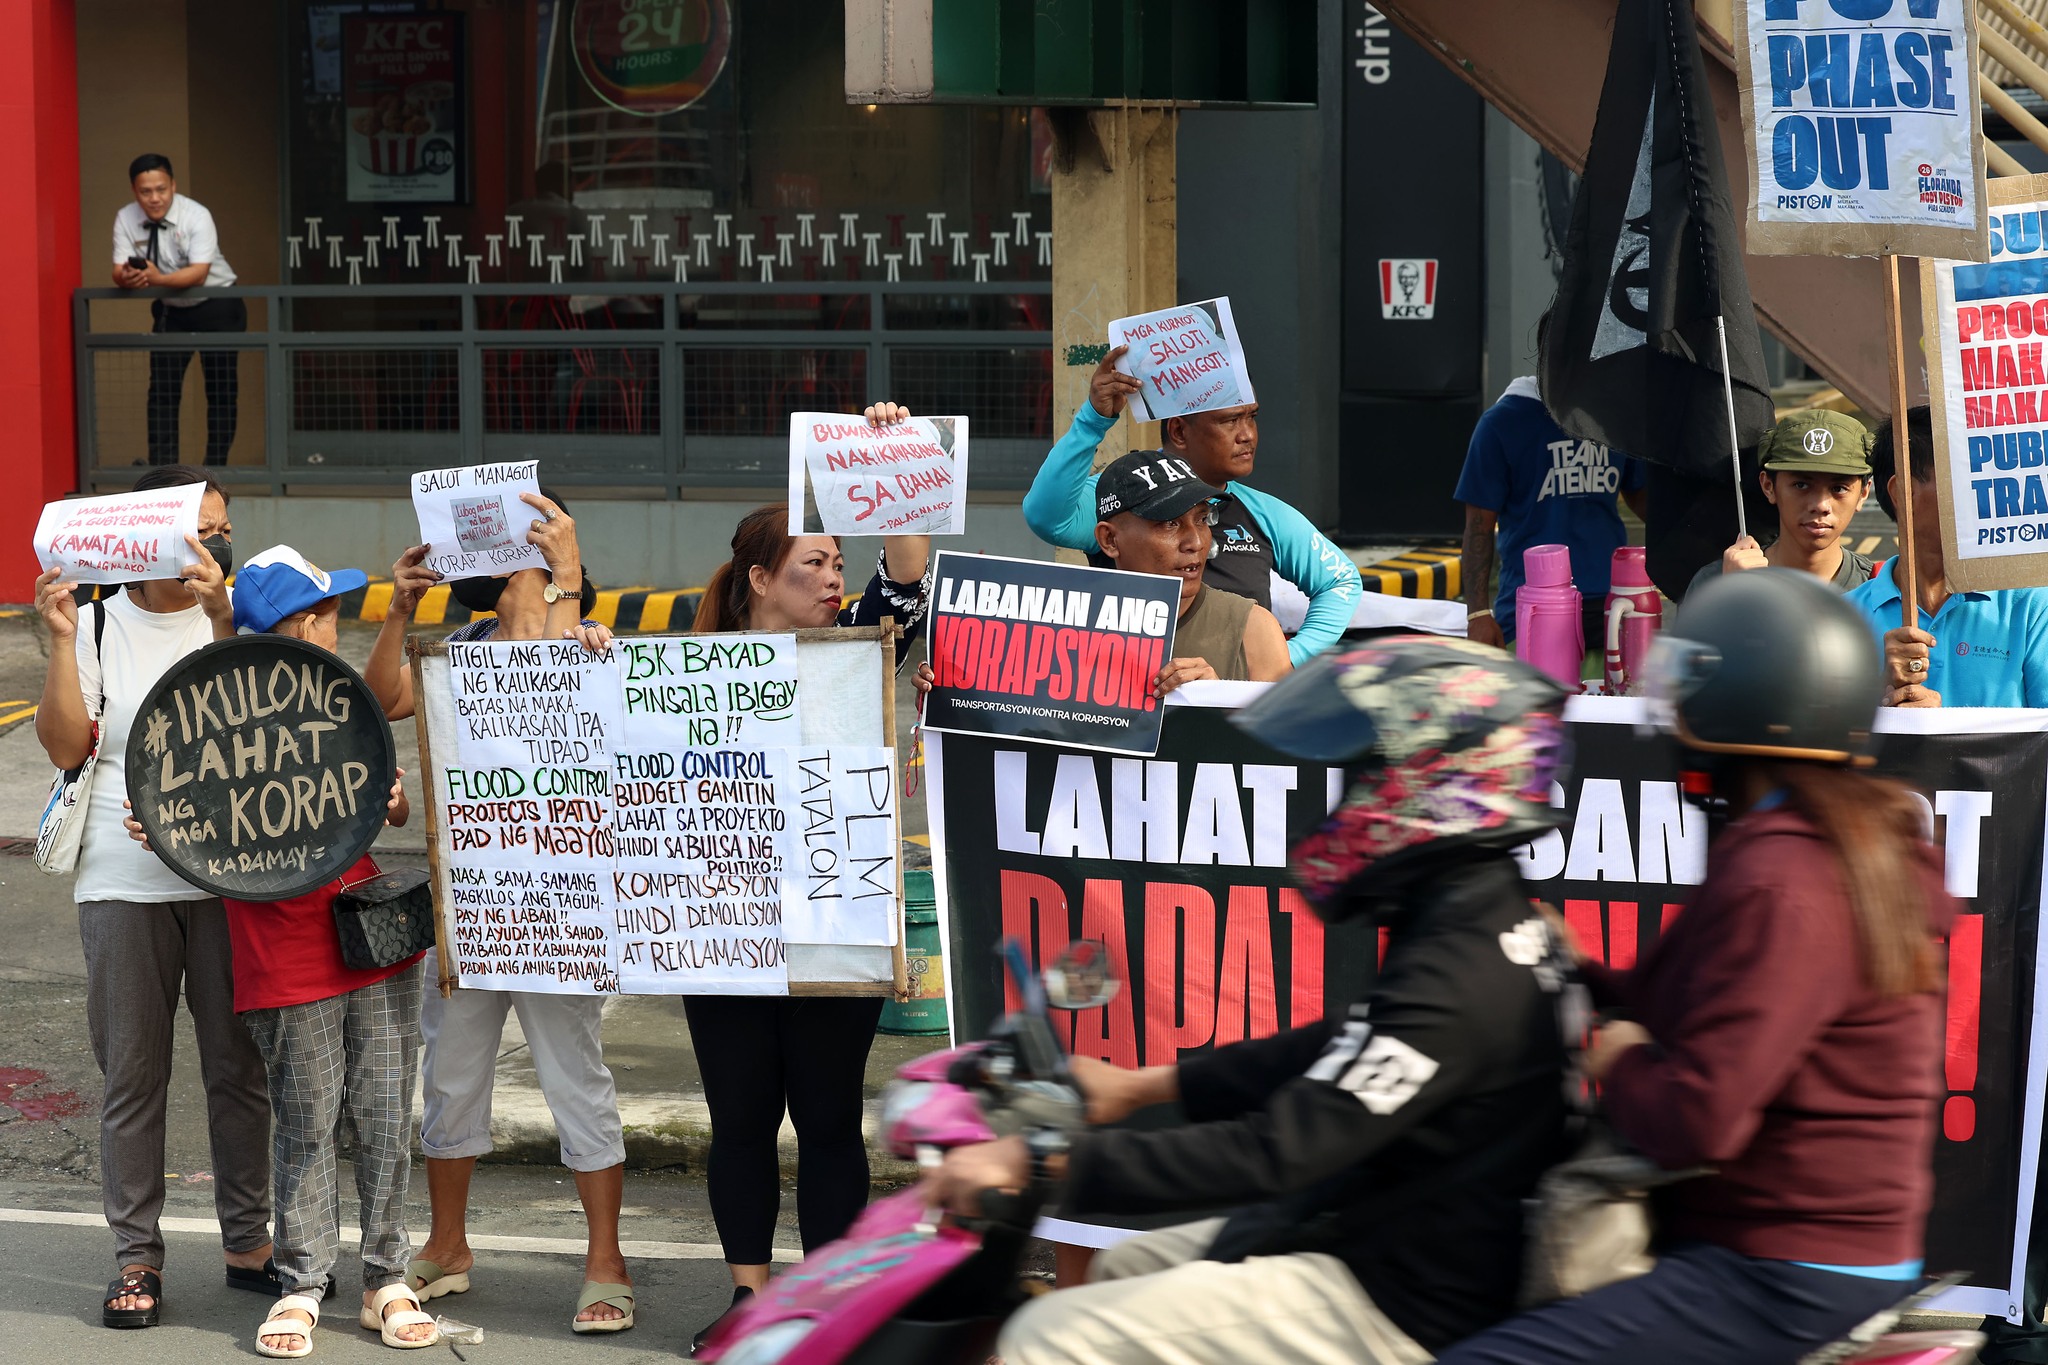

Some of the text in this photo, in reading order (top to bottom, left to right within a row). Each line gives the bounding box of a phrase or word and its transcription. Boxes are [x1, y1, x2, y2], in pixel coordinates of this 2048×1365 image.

[363, 21, 444, 49] KFC
[618, 7, 682, 52] 24
[355, 51, 450, 64] FLAVOR SHOTS
[379, 63, 428, 75] FILL UP
[616, 51, 672, 70] HOURS
[1767, 32, 1955, 110] PHASE
[1772, 115, 1892, 191] OUT
[1777, 194, 1833, 210] PISTON
[1391, 305, 1425, 317] KFC
[1123, 324, 1156, 343] MGA
[1150, 329, 1210, 365] SALOT!
[1151, 351, 1229, 396] MANAGOT!
[1960, 342, 2048, 392] MAK
[826, 442, 944, 471] NAKIKINABANG
[1547, 439, 1609, 469] TEAM
[419, 469, 463, 493] SALOT
[847, 465, 954, 522] SA BAHA!
[1537, 466, 1620, 502] ATENEO
[1099, 500, 1122, 515] TULFO
[1100, 493, 1117, 506] Erwin
[63, 514, 176, 529] SA GUBYERNONG
[49, 533, 159, 563] KAWATAN!
[487, 544, 540, 566] KORAP!
[1222, 544, 1261, 552] ANGKAS
[937, 577, 1170, 637] LABANAN ANG
[450, 644, 502, 669] ITIGIL
[507, 645, 542, 669] ANG
[681, 642, 775, 673] BAYAD
[933, 615, 1165, 713] KORAPSYON!
[462, 671, 488, 695] NG
[144, 659, 351, 757] #IKULONG
[508, 696, 529, 714] NA
[951, 698, 1130, 728] TRANSPORTASYON KONTRA KORAPSYON
[468, 714, 568, 740] KALIKASAN
[160, 722, 338, 793] LAHAT
[682, 751, 773, 780] CONTROL
[533, 767, 612, 798] CONTROL
[614, 780, 775, 808] BUDGET GAMITIN
[157, 798, 195, 825] NG
[229, 762, 369, 847] KORAP
[447, 800, 541, 825] PROJECTS
[994, 750, 1298, 868] LAHAT
[615, 807, 786, 832] LAHAT SA PROYEKTO
[798, 749, 843, 901] TATALON
[846, 764, 893, 900] PLM
[170, 819, 217, 849] MGA
[450, 828, 491, 850] PAD
[500, 825, 528, 850] NG
[615, 834, 774, 860] HINDI SA BULSA NG
[449, 867, 487, 886] NASA
[613, 871, 778, 903] KOMPENSASYON
[452, 889, 515, 906] PAGKILOS
[521, 890, 550, 908] ANG
[455, 908, 479, 924] PAY
[485, 908, 506, 925] NG
[615, 901, 782, 934] HINDI DEMOLISYON
[456, 925, 482, 943] MAY
[486, 925, 530, 942] AYUDA
[456, 943, 607, 959] TRABAHO AT KABUHAYAN
[623, 937, 787, 973] AT REKLAMASYON
[459, 961, 492, 976] PADIN
[495, 960, 520, 975] ANG
[522, 961, 556, 976] AMING
